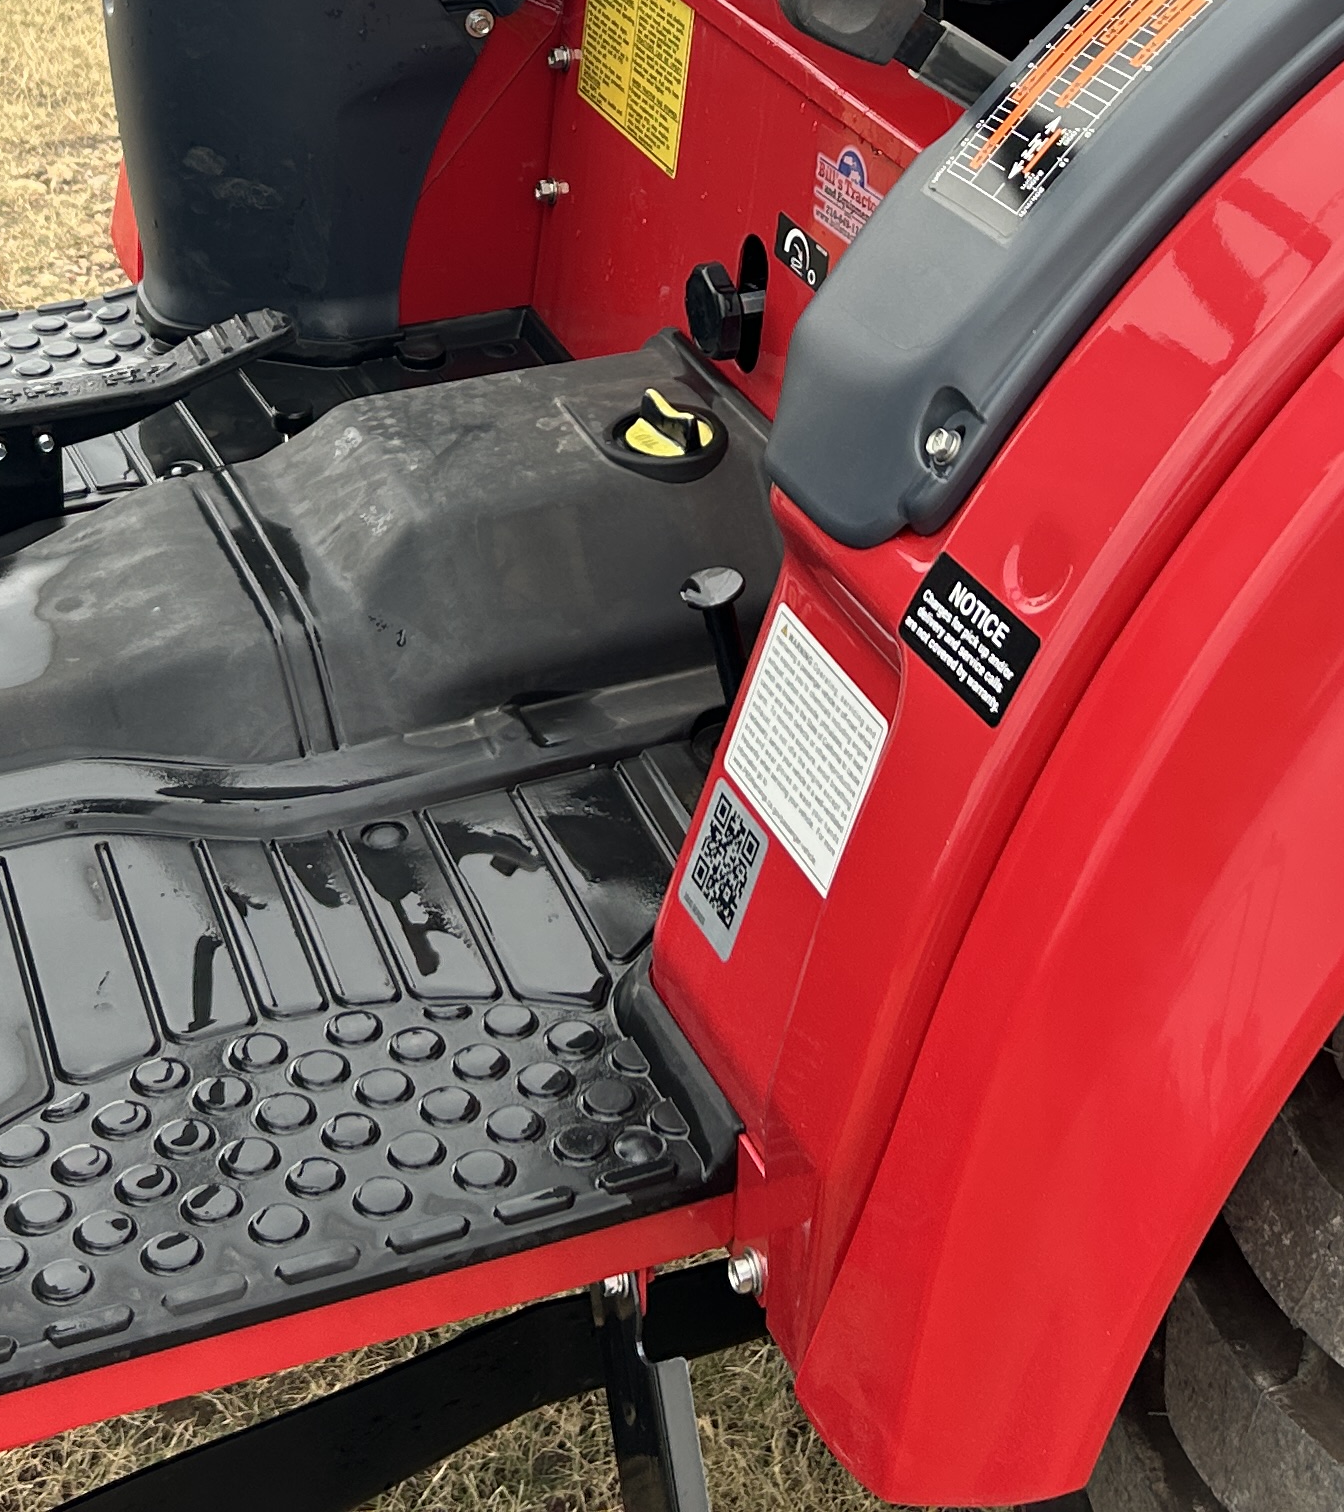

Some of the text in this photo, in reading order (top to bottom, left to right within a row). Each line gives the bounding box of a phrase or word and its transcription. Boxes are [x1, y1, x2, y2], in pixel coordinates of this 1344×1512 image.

[817, 160, 843, 190] Bill's
[917, 607, 946, 639] delivery
[944, 633, 961, 651] and
[958, 646, 985, 676] service
[923, 589, 1014, 680] Charges for pick up and/or
[948, 582, 1010, 648] NOTICE
[789, 633, 813, 666] WARNING
[905, 616, 917, 632] are
[916, 627, 930, 644] not
[928, 639, 959, 671] covered
[956, 663, 967, 682] by
